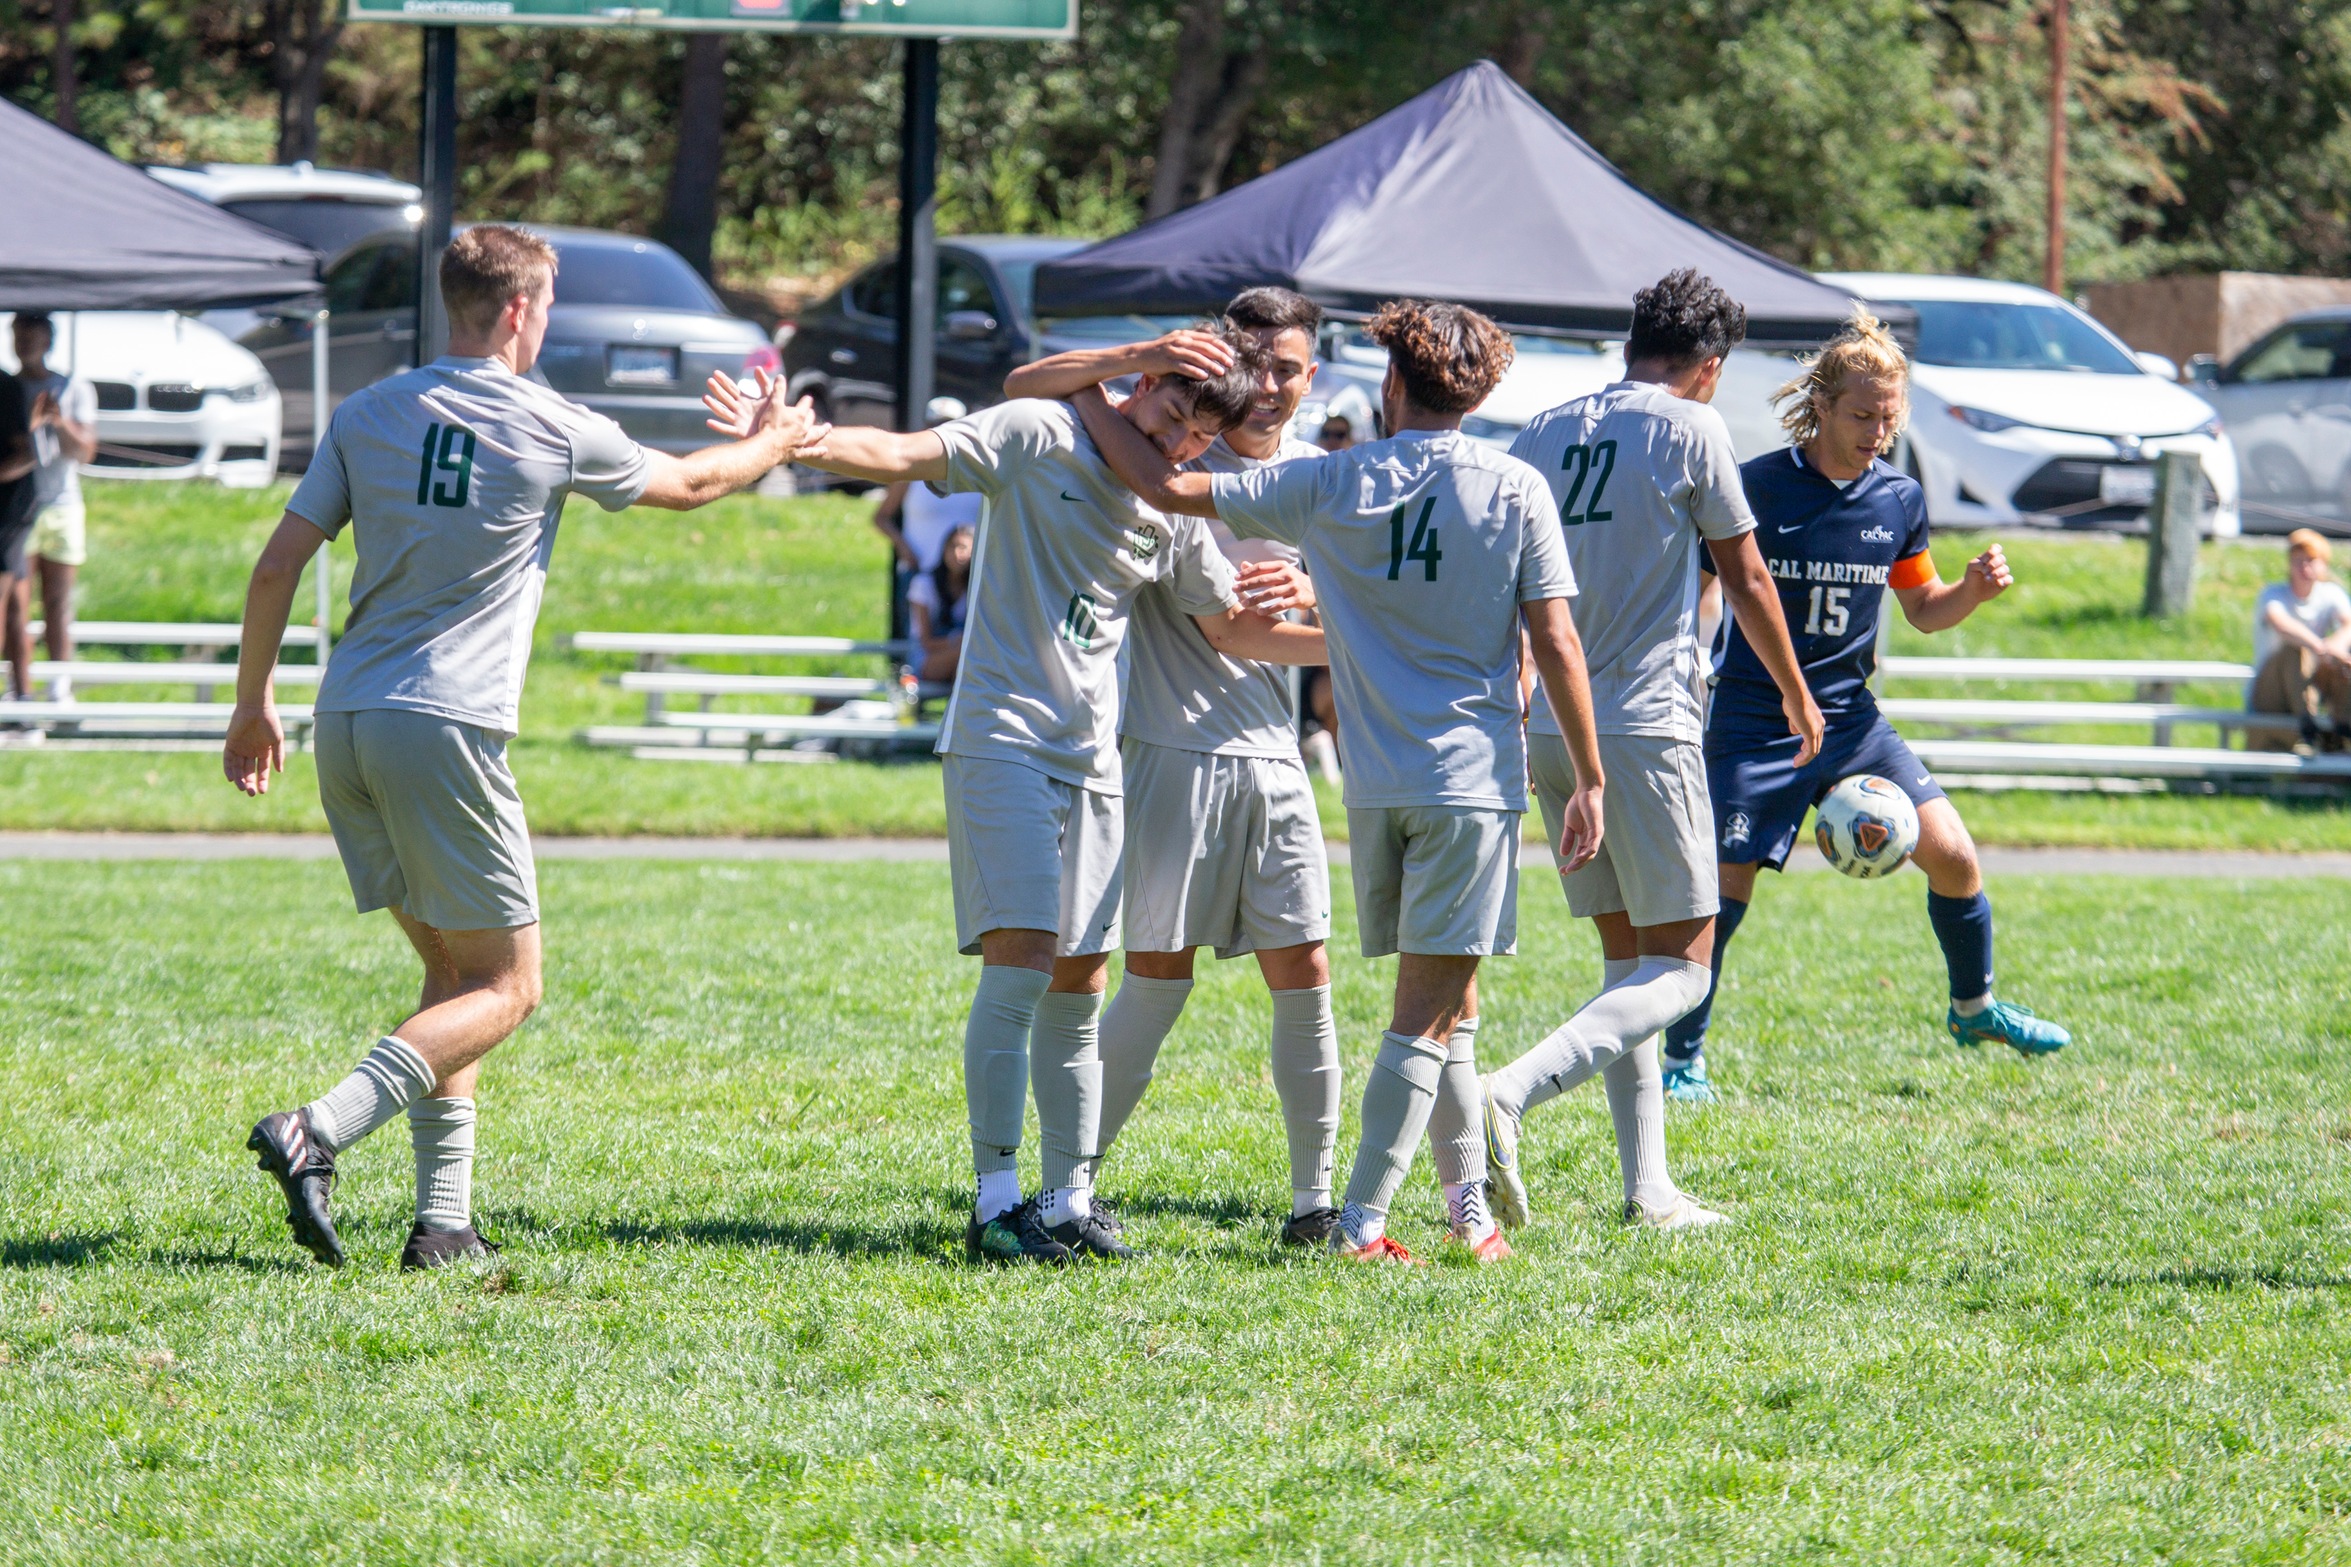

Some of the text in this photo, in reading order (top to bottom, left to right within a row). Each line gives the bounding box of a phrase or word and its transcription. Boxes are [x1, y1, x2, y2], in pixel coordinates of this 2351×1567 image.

[417, 421, 476, 508] 19
[1561, 439, 1617, 526] 22
[1387, 495, 1443, 582] 14
[1768, 558, 1890, 585] CAL MARITIME
[1063, 589, 1097, 649] 10
[1804, 585, 1851, 636] 15
